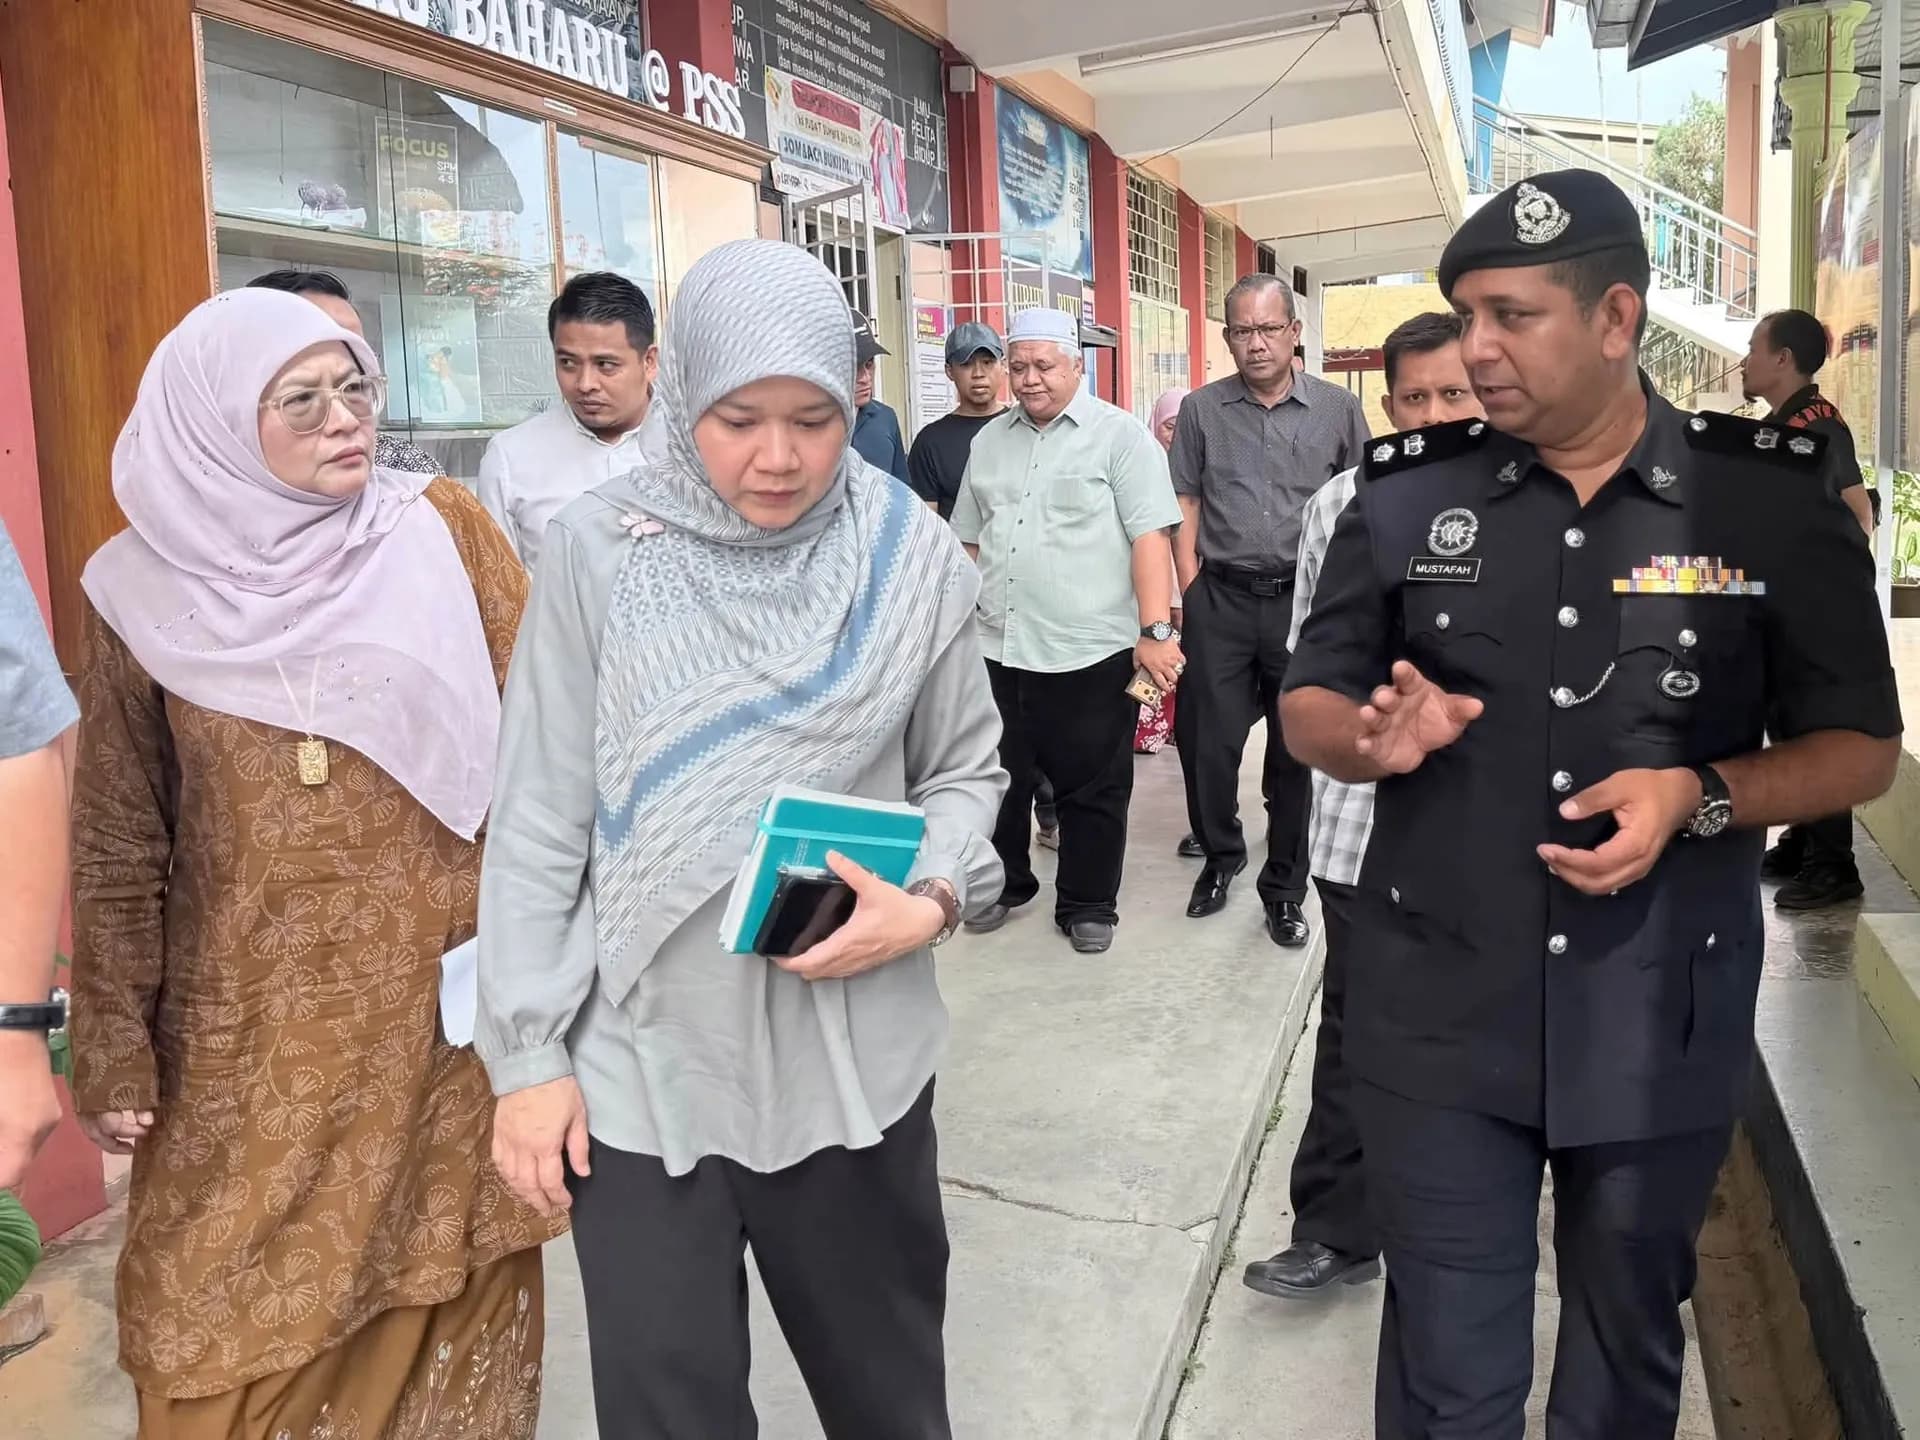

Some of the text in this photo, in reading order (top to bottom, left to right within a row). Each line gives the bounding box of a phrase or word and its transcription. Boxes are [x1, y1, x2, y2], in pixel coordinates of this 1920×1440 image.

[800, 6, 815, 25] yang
[454, 0, 629, 97] BAHARU
[641, 49, 670, 113] @
[679, 61, 746, 140] PSS
[379, 135, 449, 160] FOCUS
[1415, 564, 1471, 575] MUSTAFAH
